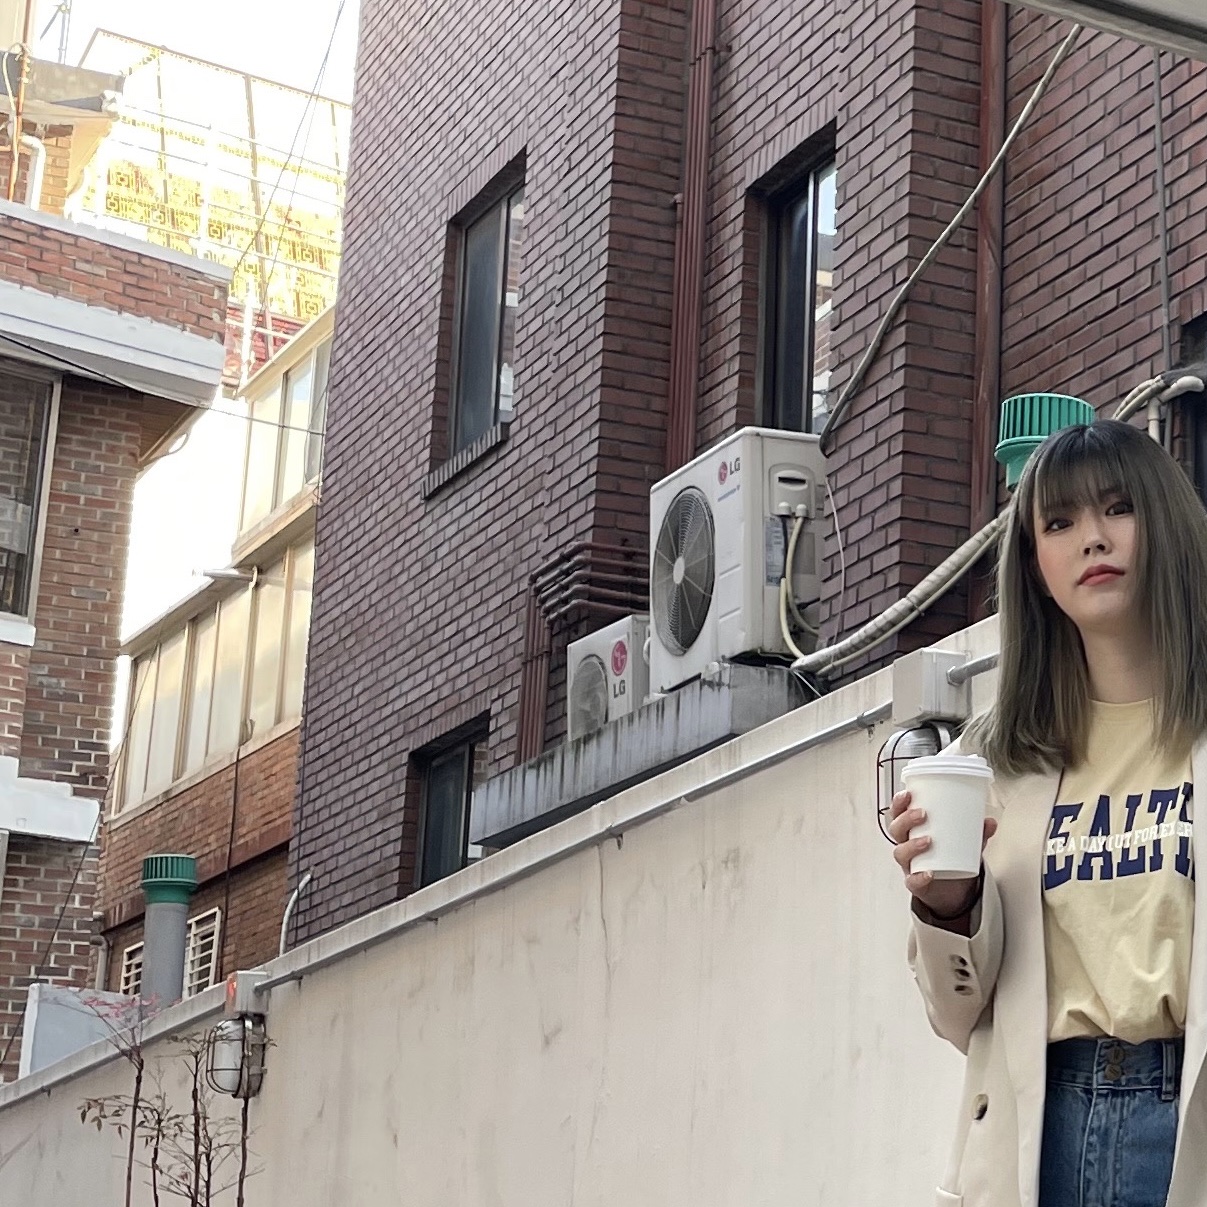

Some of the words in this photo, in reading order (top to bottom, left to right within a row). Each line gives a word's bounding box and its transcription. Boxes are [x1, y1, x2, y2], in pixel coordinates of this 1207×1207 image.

[729, 457, 741, 476] LG
[612, 679, 626, 698] LG
[1080, 835, 1107, 854] DAY
[1133, 824, 1158, 846] FOR
